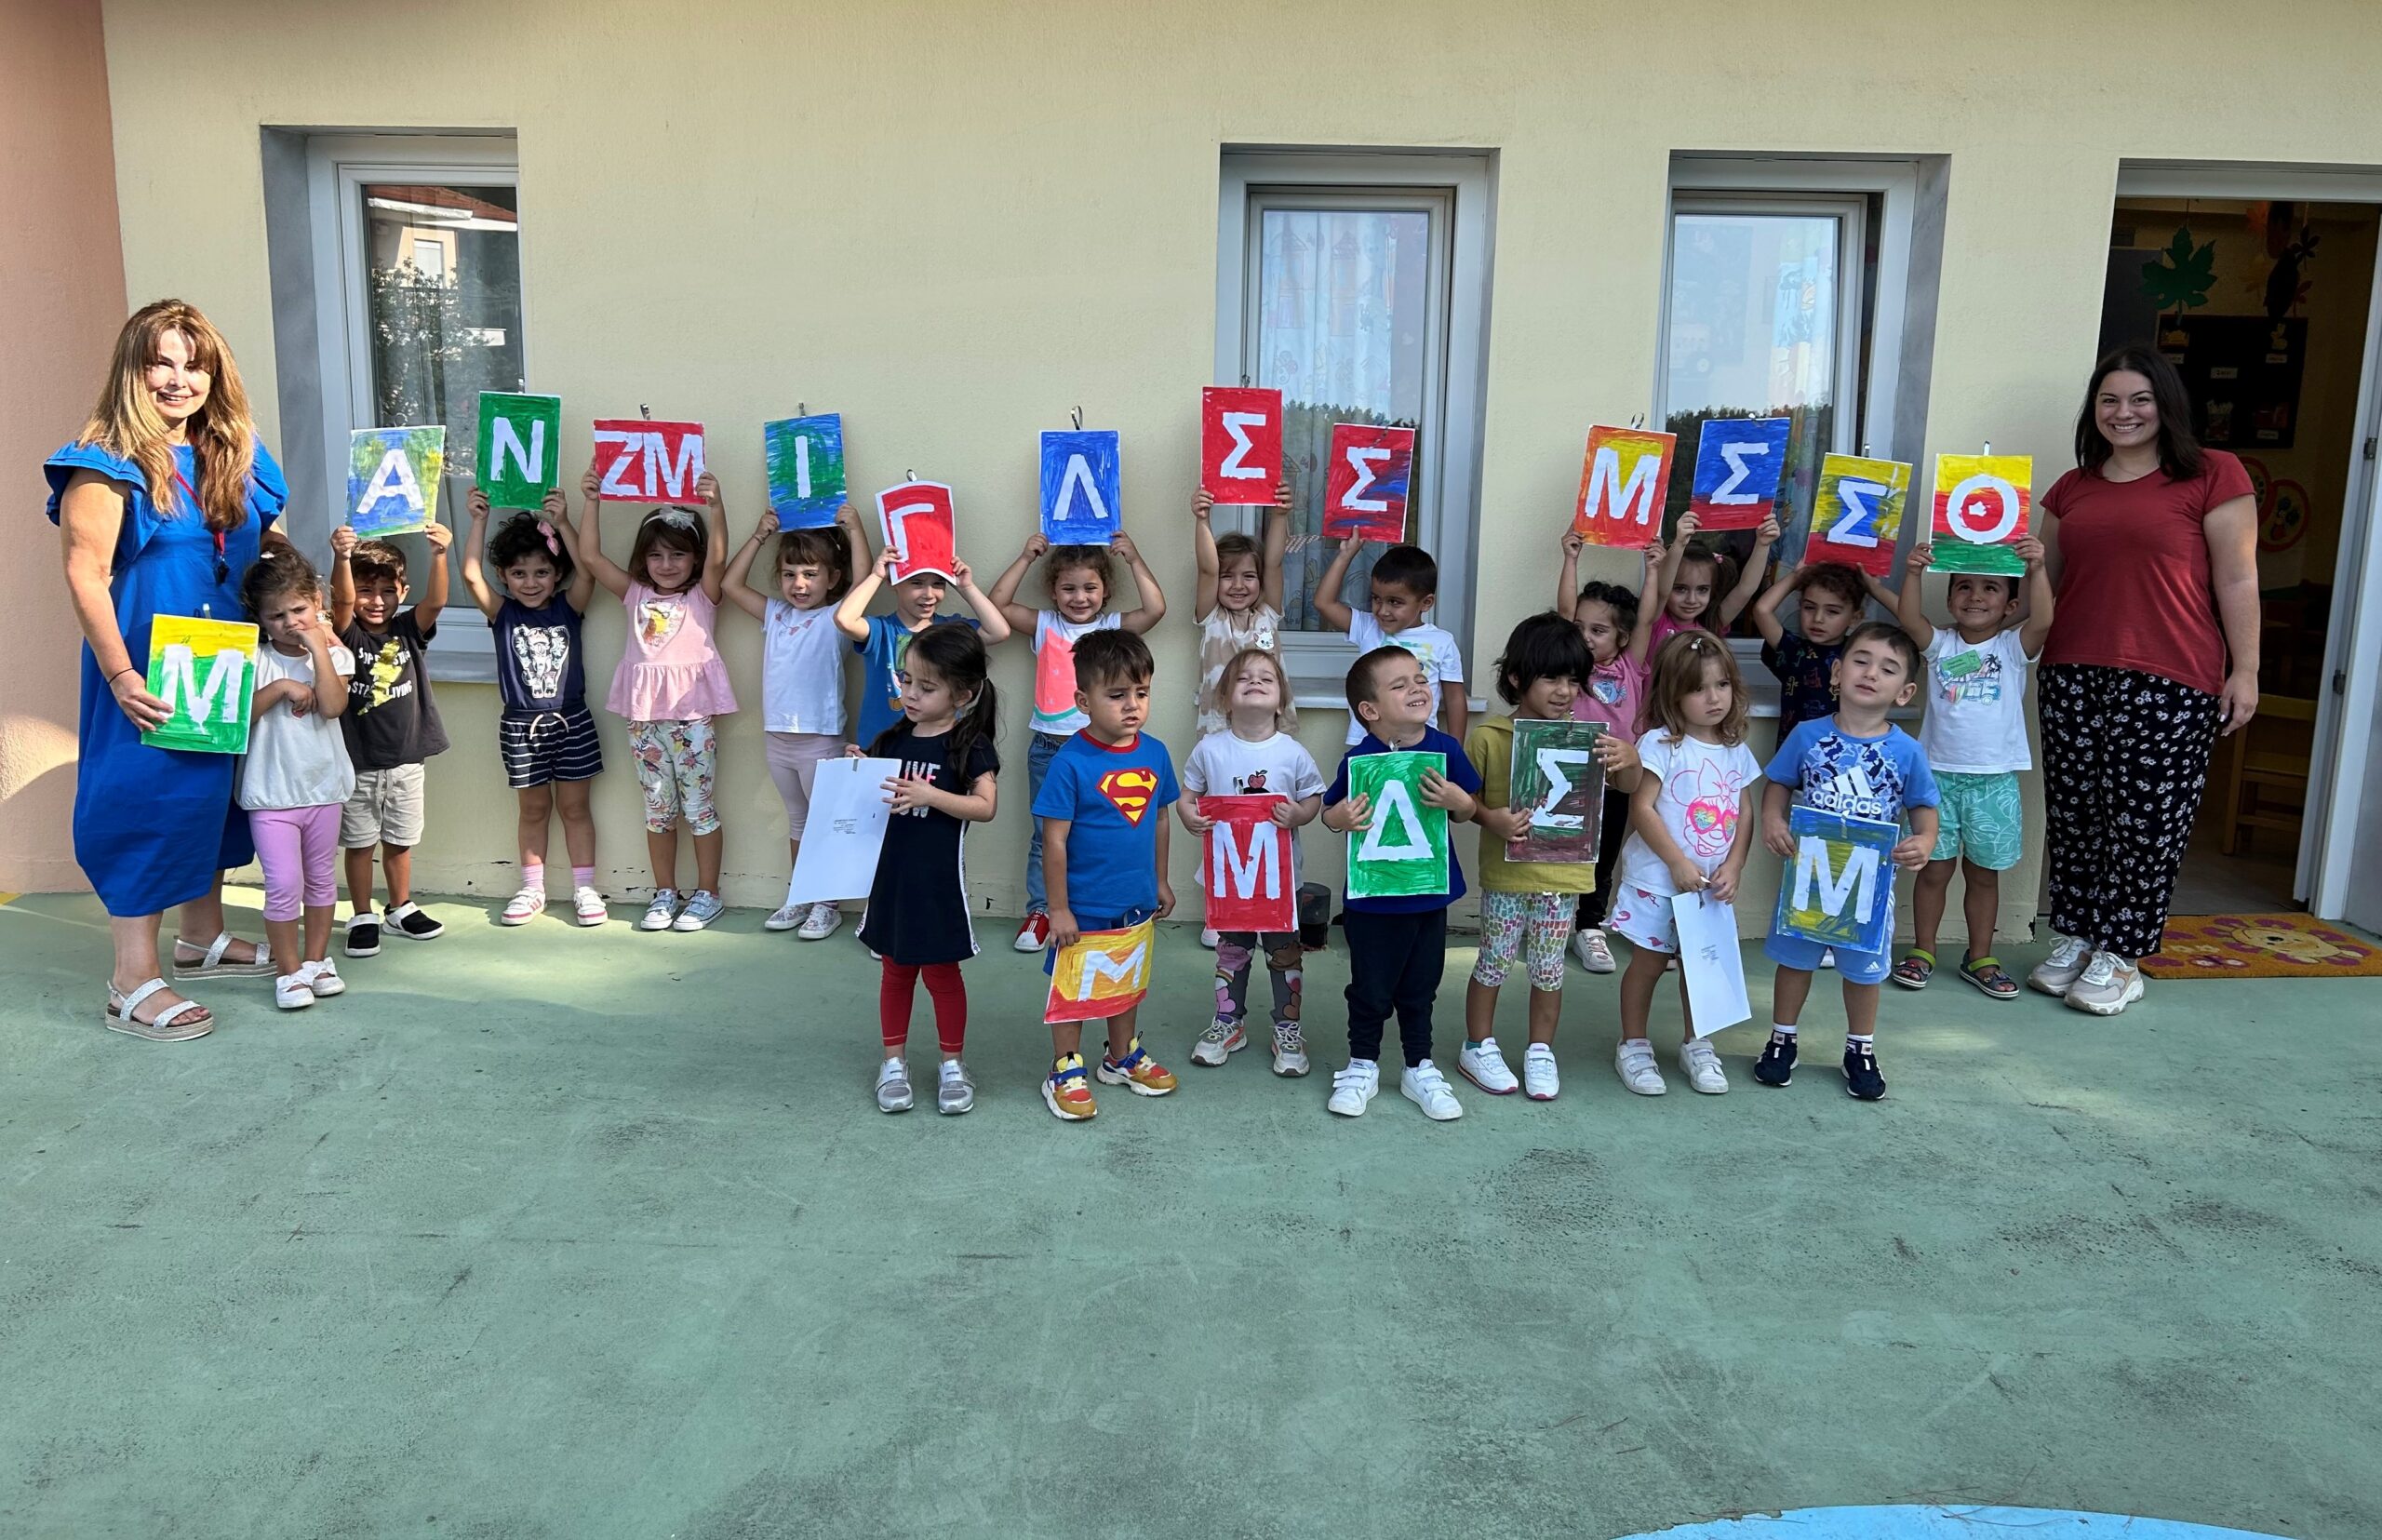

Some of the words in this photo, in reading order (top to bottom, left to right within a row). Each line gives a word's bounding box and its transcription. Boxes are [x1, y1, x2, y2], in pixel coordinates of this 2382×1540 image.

[1221, 412, 1266, 478] Σ
[1711, 442, 1770, 504] Σ
[1342, 447, 1391, 512] Σ
[1827, 479, 1888, 548] Σ
[1357, 779, 1435, 862] Δ
[1529, 747, 1589, 830] Σ
[1813, 790, 1882, 814] adidas
